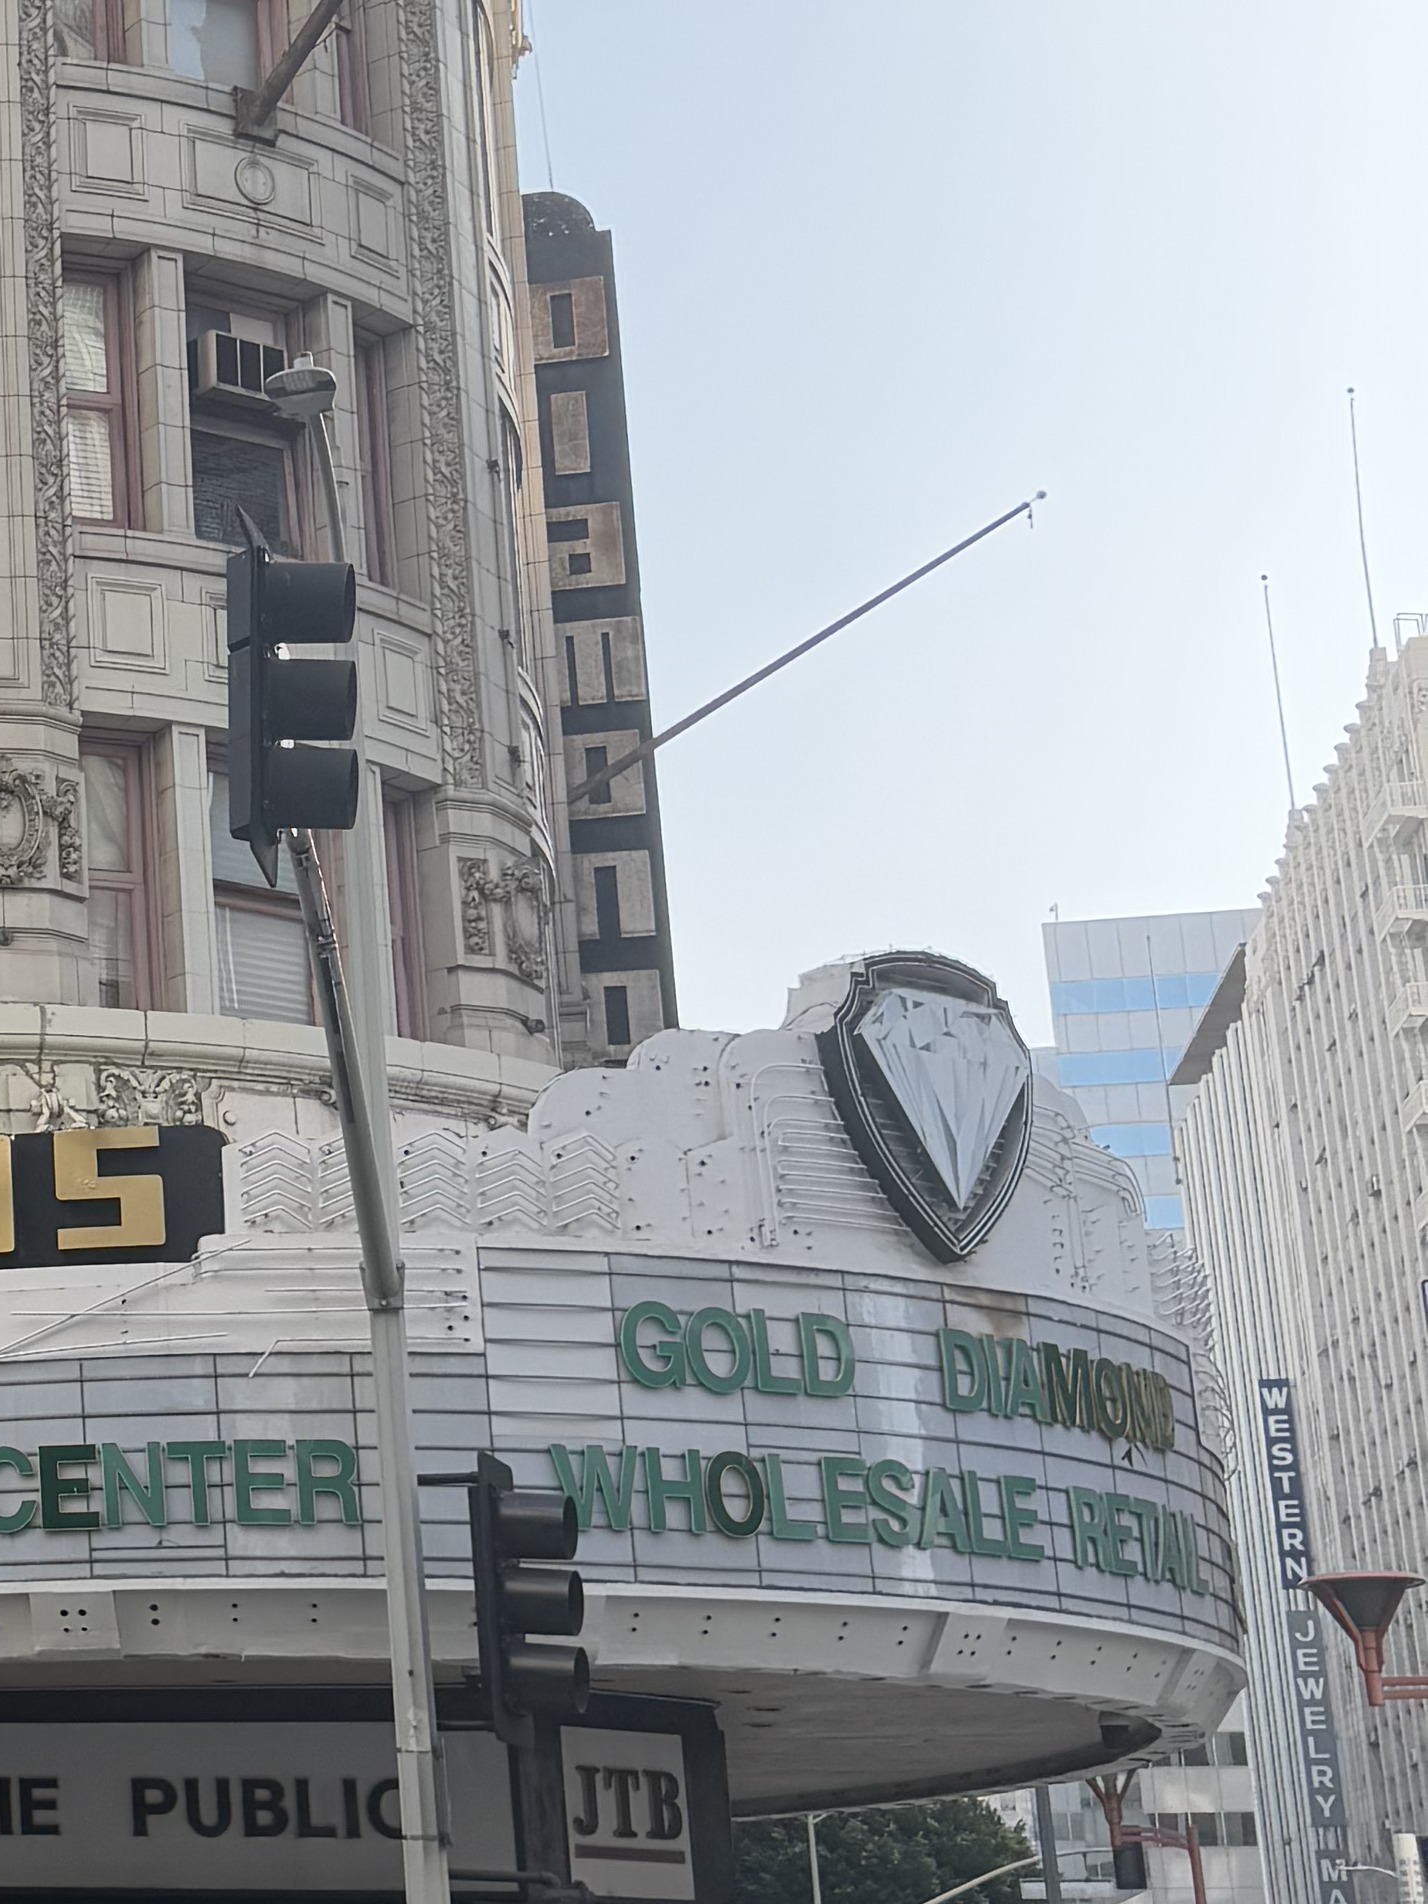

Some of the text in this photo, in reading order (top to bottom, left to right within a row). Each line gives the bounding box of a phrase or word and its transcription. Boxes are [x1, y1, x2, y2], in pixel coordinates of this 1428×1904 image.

[620, 1300, 855, 1397] GOLD
[549, 1443, 1211, 1596] WHOLESALE RETAIL
[1261, 1386, 1307, 1580] WESTERN
[1293, 1619, 1338, 1821] JEWELRY
[574, 1763, 684, 1841] JTB
